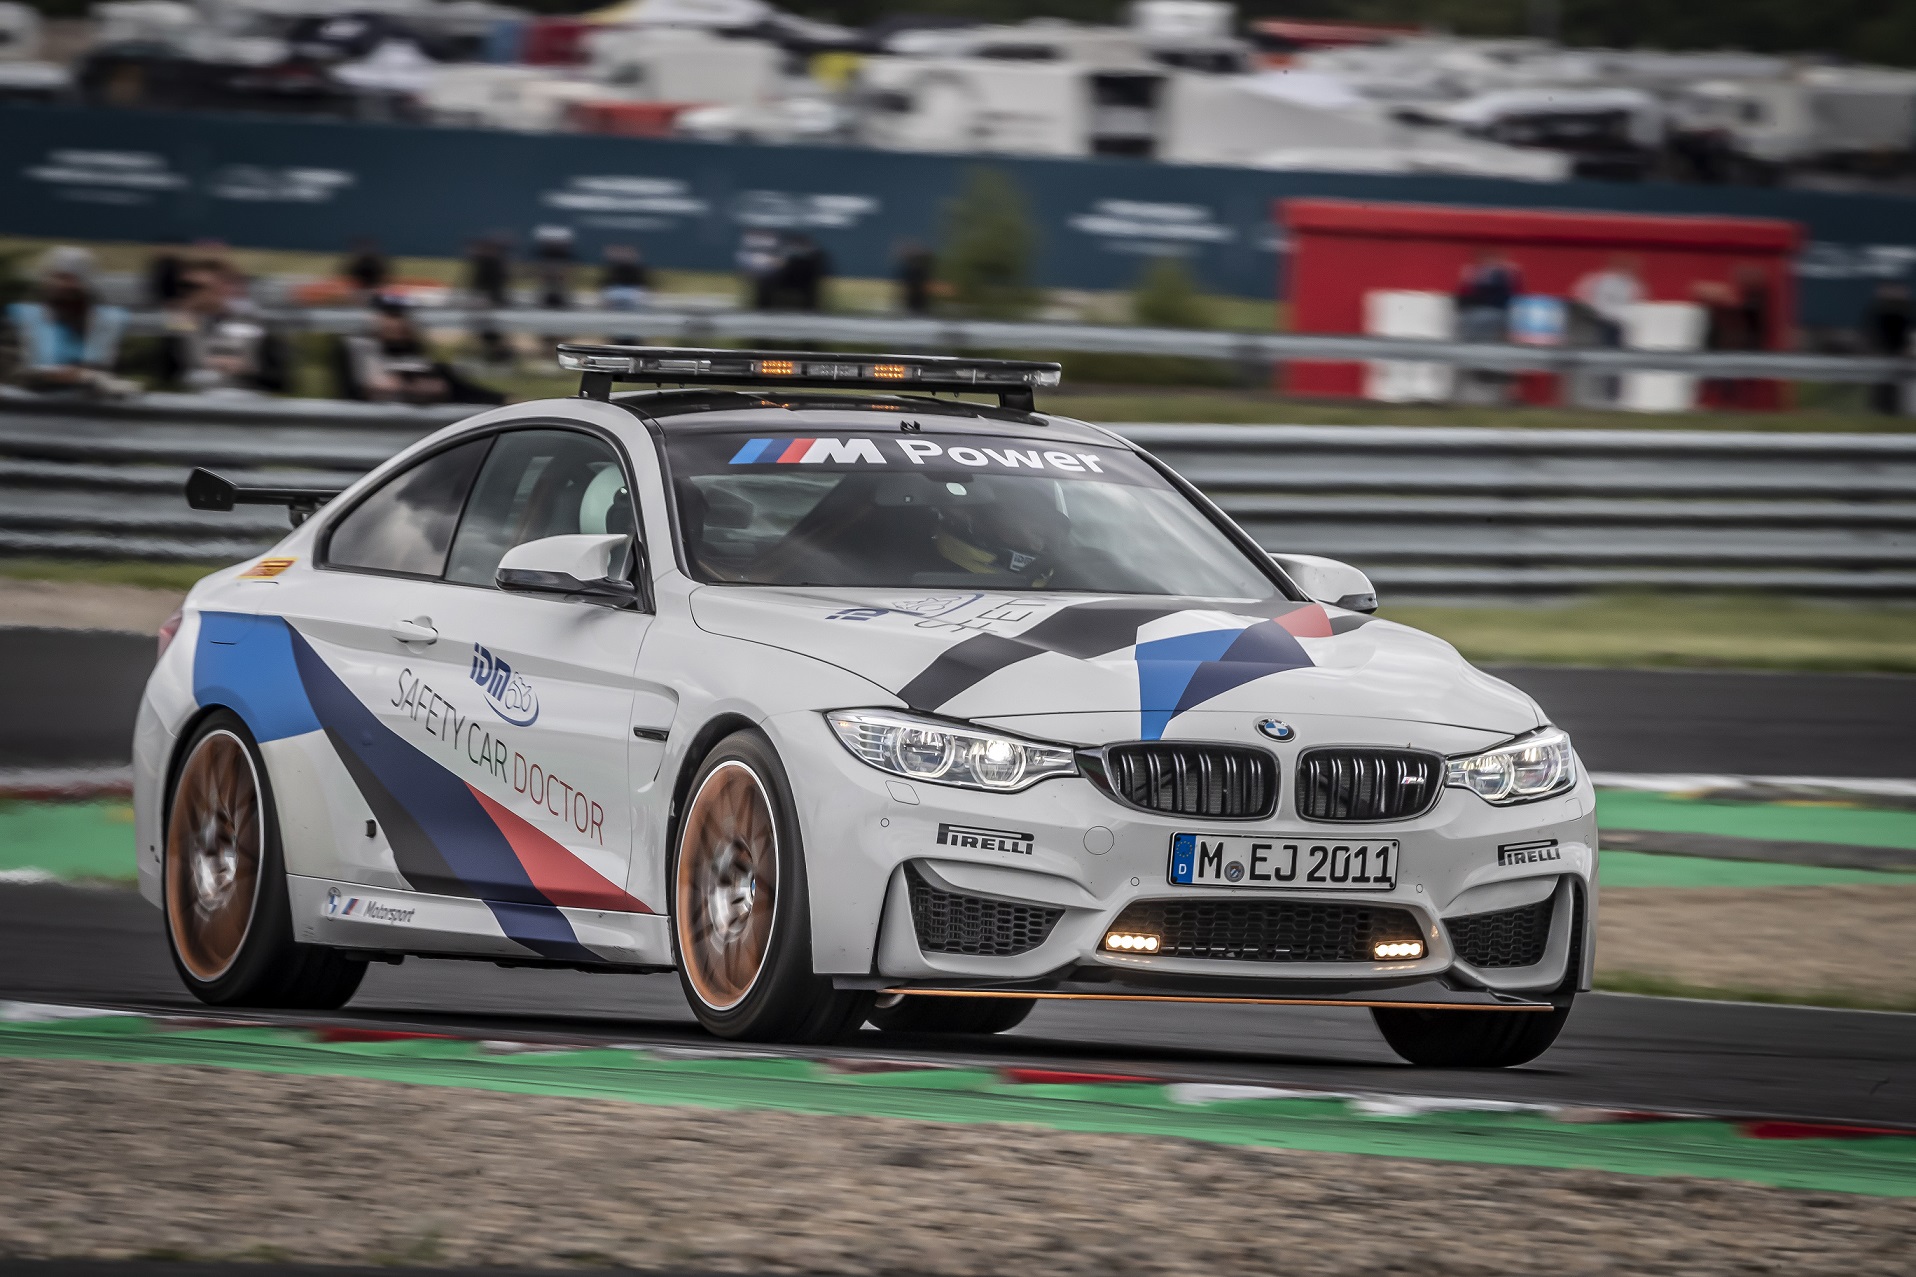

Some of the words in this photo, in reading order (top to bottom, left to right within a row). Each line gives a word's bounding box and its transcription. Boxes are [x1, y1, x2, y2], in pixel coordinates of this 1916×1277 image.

[800, 438, 888, 464] M
[895, 439, 1105, 473] Power
[391, 668, 466, 750] SAFETY
[468, 722, 507, 784] CAR
[514, 751, 604, 846] DOCTOR
[936, 822, 1035, 855] PIRELLI
[1497, 838, 1561, 867] PIRELLI
[1178, 863, 1188, 875] D
[1199, 841, 1224, 879] M
[1250, 843, 1299, 882] EJ
[1306, 845, 1393, 883] 2011
[363, 900, 416, 925] Motorsport
